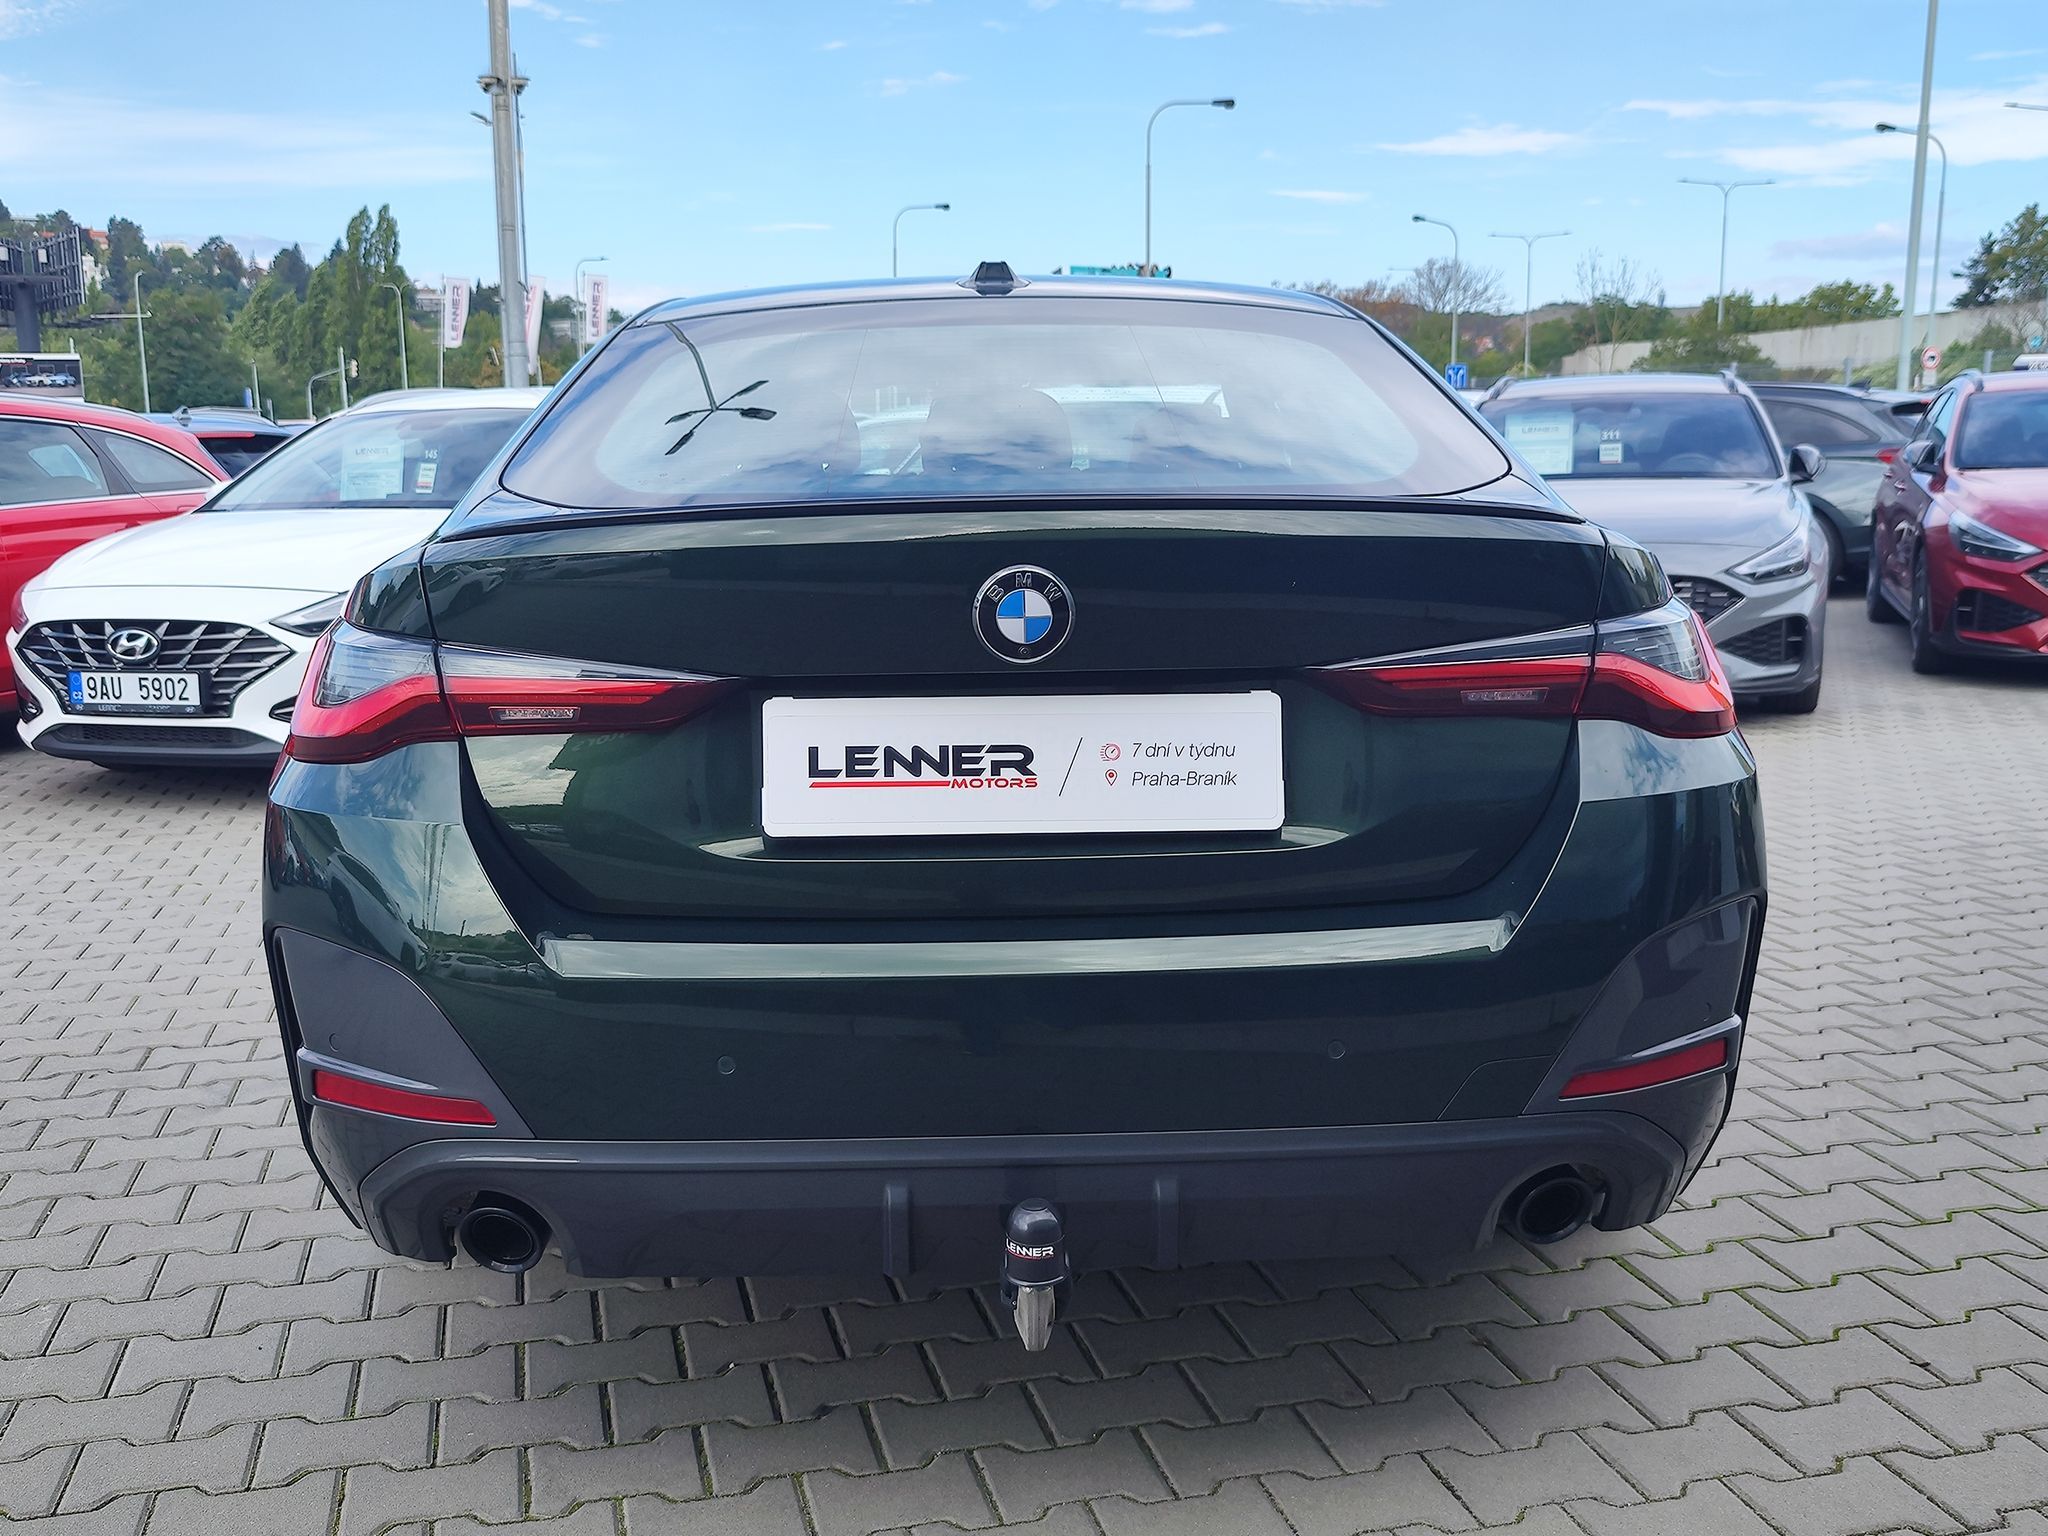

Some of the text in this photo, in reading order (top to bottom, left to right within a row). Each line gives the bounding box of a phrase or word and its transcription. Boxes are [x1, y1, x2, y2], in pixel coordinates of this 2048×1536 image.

[451, 286, 461, 341] LENNER
[592, 282, 600, 337] LENNER
[986, 572, 1063, 603] BMW
[86, 676, 189, 700] 9AU 5902
[808, 744, 1038, 778] LENNER
[1132, 742, 1236, 760] 7 dní v týdnu
[951, 777, 1038, 789] MOTORS
[1131, 770, 1238, 786] Praha-Braník
[1006, 1238, 1054, 1257] LENNER
